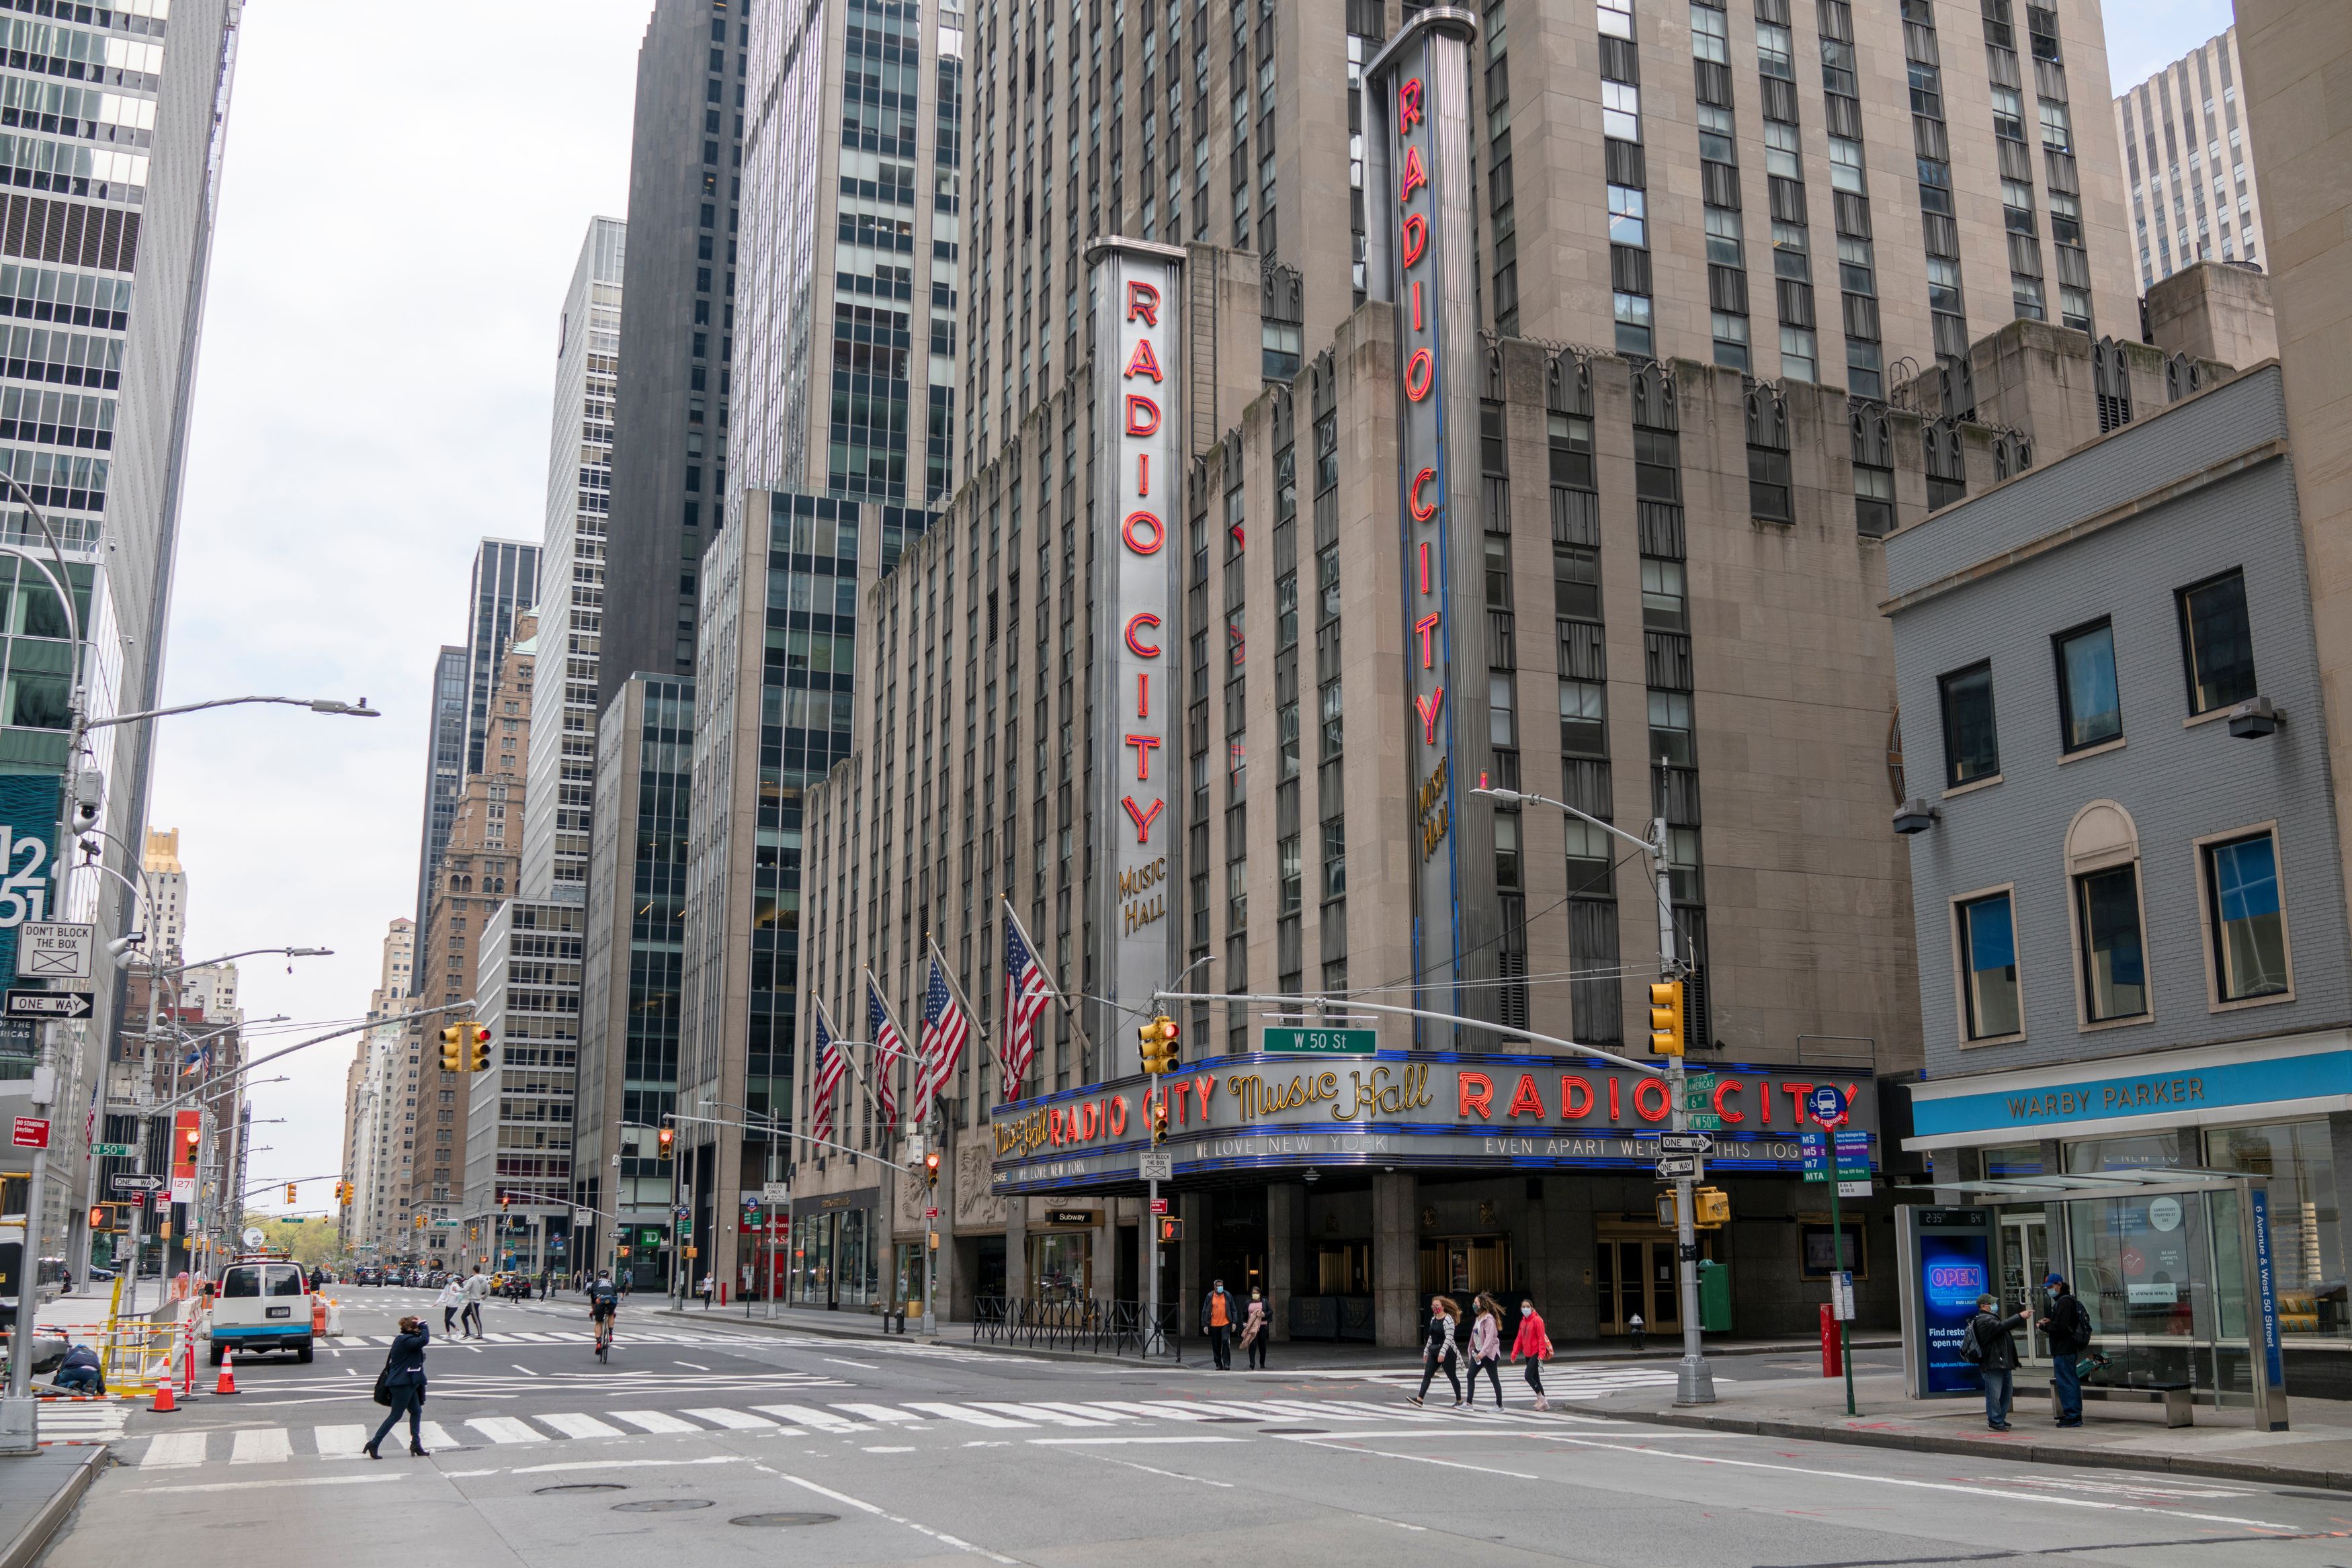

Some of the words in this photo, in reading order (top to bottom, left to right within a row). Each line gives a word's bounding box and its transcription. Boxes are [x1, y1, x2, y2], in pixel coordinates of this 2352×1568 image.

[1400, 77, 1433, 401] RADIO
[1122, 279, 1165, 554] RADIO
[1411, 467, 1444, 746] CITY
[1121, 613, 1164, 843] CITY
[1119, 857, 1166, 904] MUSIC
[1125, 894, 1166, 937] HALL
[26, 926, 54, 936] DON'T
[57, 928, 89, 938] BLOCK
[36, 939, 54, 948] THE
[58, 939, 77, 949] BOX
[19, 998, 44, 1009] ONE
[56, 1000, 81, 1010] WAY
[1294, 1034, 1304, 1049] W
[1310, 1034, 1327, 1049] 50
[1333, 1034, 1347, 1049] St
[1688, 1079, 1714, 1092] AMERICAS
[1227, 1072, 1339, 1122] Music
[1332, 1063, 1433, 1121] Hall
[1459, 1072, 1672, 1121] RADIO
[2007, 1090, 2089, 1119] WARBY
[2103, 1077, 2204, 1109] PARKER
[1142, 1074, 1216, 1131] CITY
[1691, 1099, 1697, 1108] 6
[24, 1121, 45, 1129] STANDING
[1050, 1095, 1128, 1147] RADIO
[1695, 1116, 1701, 1127] W
[1702, 1117, 1712, 1128] 50
[1820, 1114, 1843, 1125] STANDING
[1665, 1139, 1682, 1147] ONE
[1691, 1139, 1707, 1147] WAY
[1802, 1134, 1815, 1144] M5
[93, 1145, 101, 1154] W
[103, 1145, 118, 1154] 50
[1196, 1142, 1208, 1158] WE
[1216, 1138, 1253, 1156] LOVE
[1269, 1136, 1311, 1152] NEW
[1330, 1135, 1386, 1151] YORK
[1486, 1138, 1532, 1154] EVEN
[1547, 1139, 1606, 1155] APART
[1621, 1140, 1661, 1156] WE'R
[1715, 1142, 1751, 1158] THIS
[1804, 1147, 1816, 1156] M5
[1019, 1170, 1027, 1180] WE
[1031, 1166, 1046, 1179] LOVE
[1050, 1162, 1064, 1176] NEW
[1068, 1159, 1085, 1174] YORK
[1660, 1163, 1673, 1172] ONE
[1679, 1162, 1691, 1170] WAY
[1805, 1159, 1818, 1168] M7
[993, 1172, 1007, 1182] CHASE
[1806, 1172, 1824, 1181] MTA
[174, 1180, 194, 1189] 1271
[1059, 1213, 1085, 1222] Subway
[1926, 1213, 1941, 1223] 2:35
[644, 1232, 658, 1243] TD
[2256, 1215, 2265, 1255] Avenue
[2260, 1258, 2267, 1266] &
[1931, 1268, 1979, 1287] OPEN
[2261, 1268, 2269, 1296] West
[2263, 1299, 2271, 1312] 50
[1929, 1328, 1945, 1336] Find
[2265, 1315, 2273, 1348] Street
[1933, 1340, 1951, 1348] open
